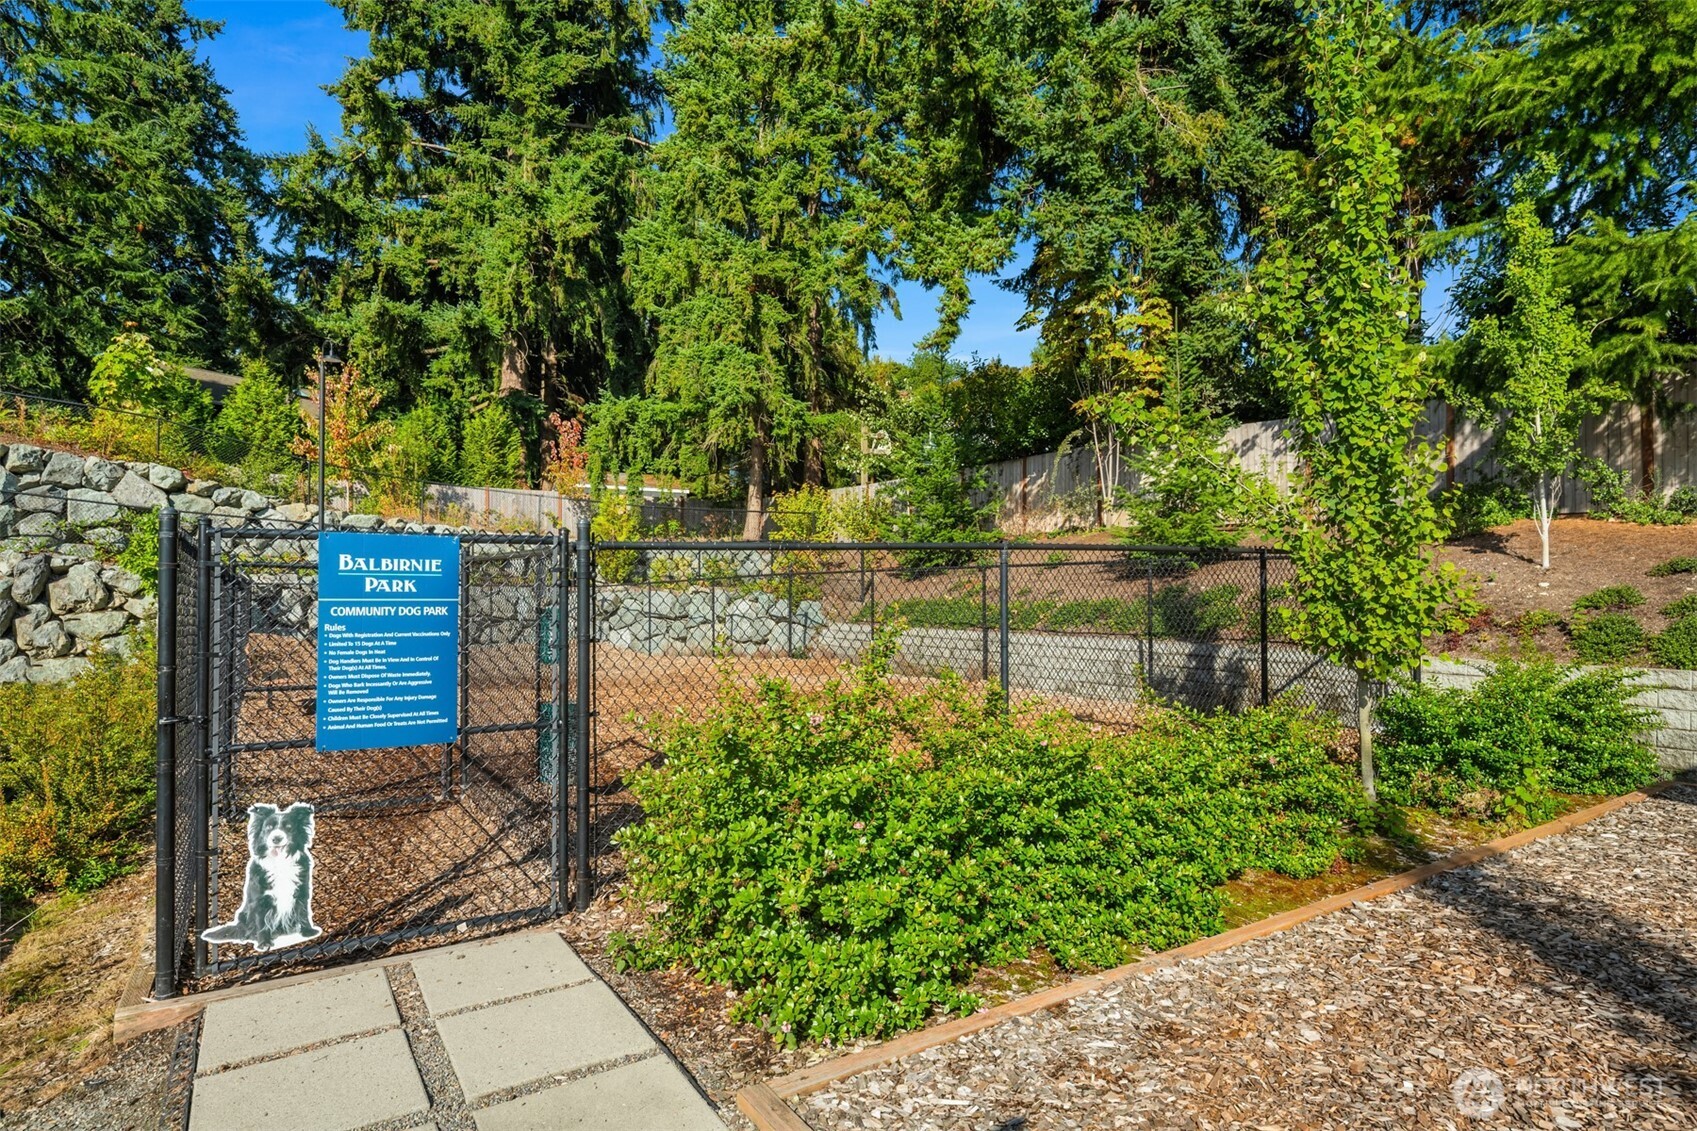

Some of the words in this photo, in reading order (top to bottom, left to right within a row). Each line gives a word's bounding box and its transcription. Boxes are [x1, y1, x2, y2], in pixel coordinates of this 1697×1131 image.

[338, 554, 442, 572] BALBIRNIE
[365, 577, 417, 592] PARK
[330, 606, 396, 616] COMMUNITY
[398, 606, 421, 616] DOG
[423, 606, 448, 616] PARK
